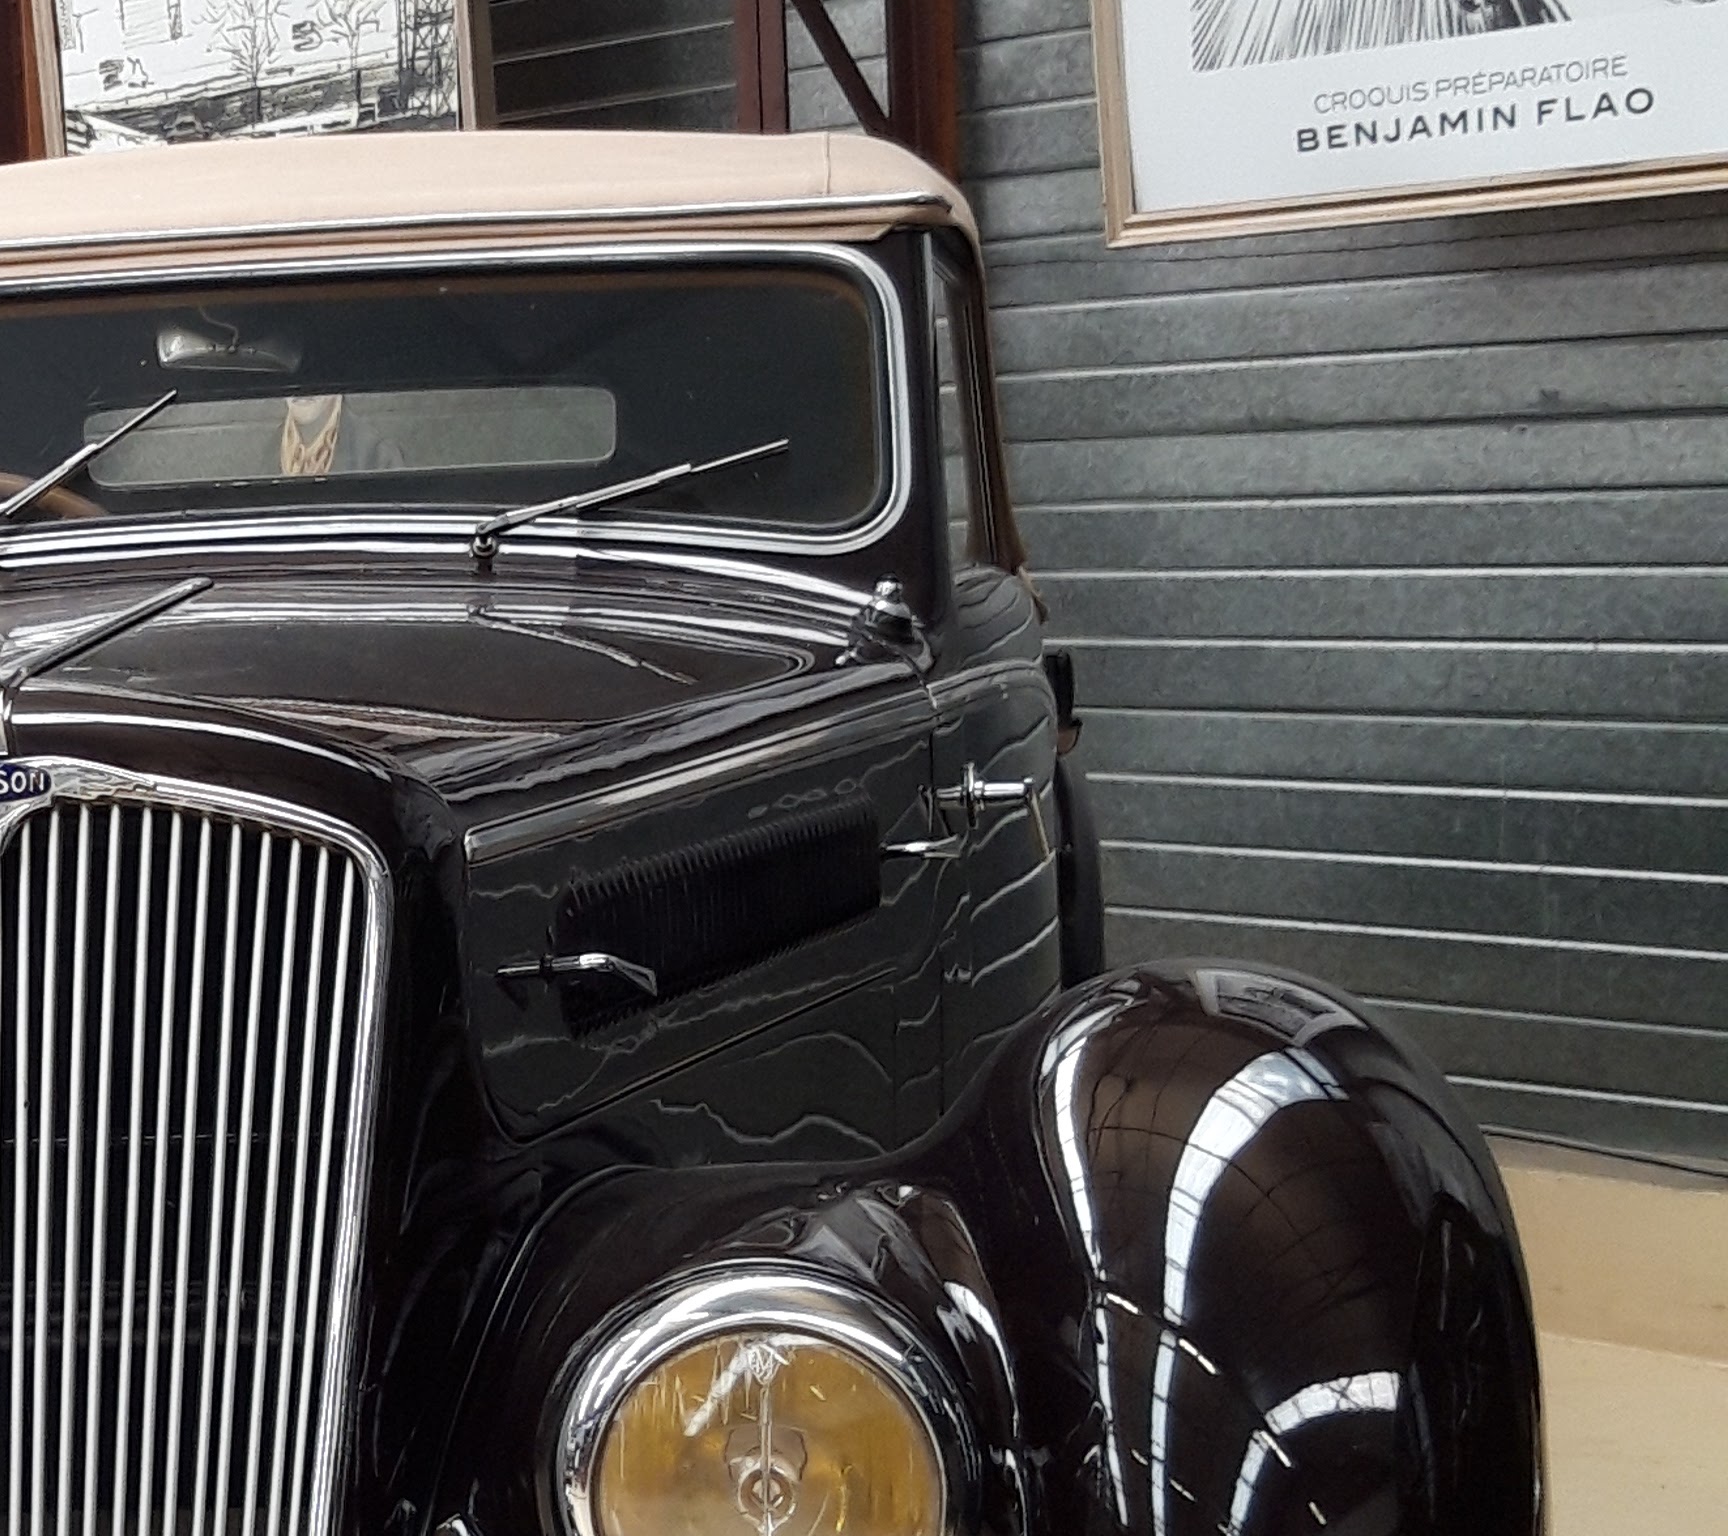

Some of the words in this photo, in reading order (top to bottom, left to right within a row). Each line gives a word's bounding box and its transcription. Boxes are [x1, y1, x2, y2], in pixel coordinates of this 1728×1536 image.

[1314, 81, 1428, 114] CROQUIS
[1435, 55, 1628, 99] PRÉPARATOIRE
[1297, 103, 1517, 153] BENJAMIN
[1537, 87, 1655, 126] FLAO
